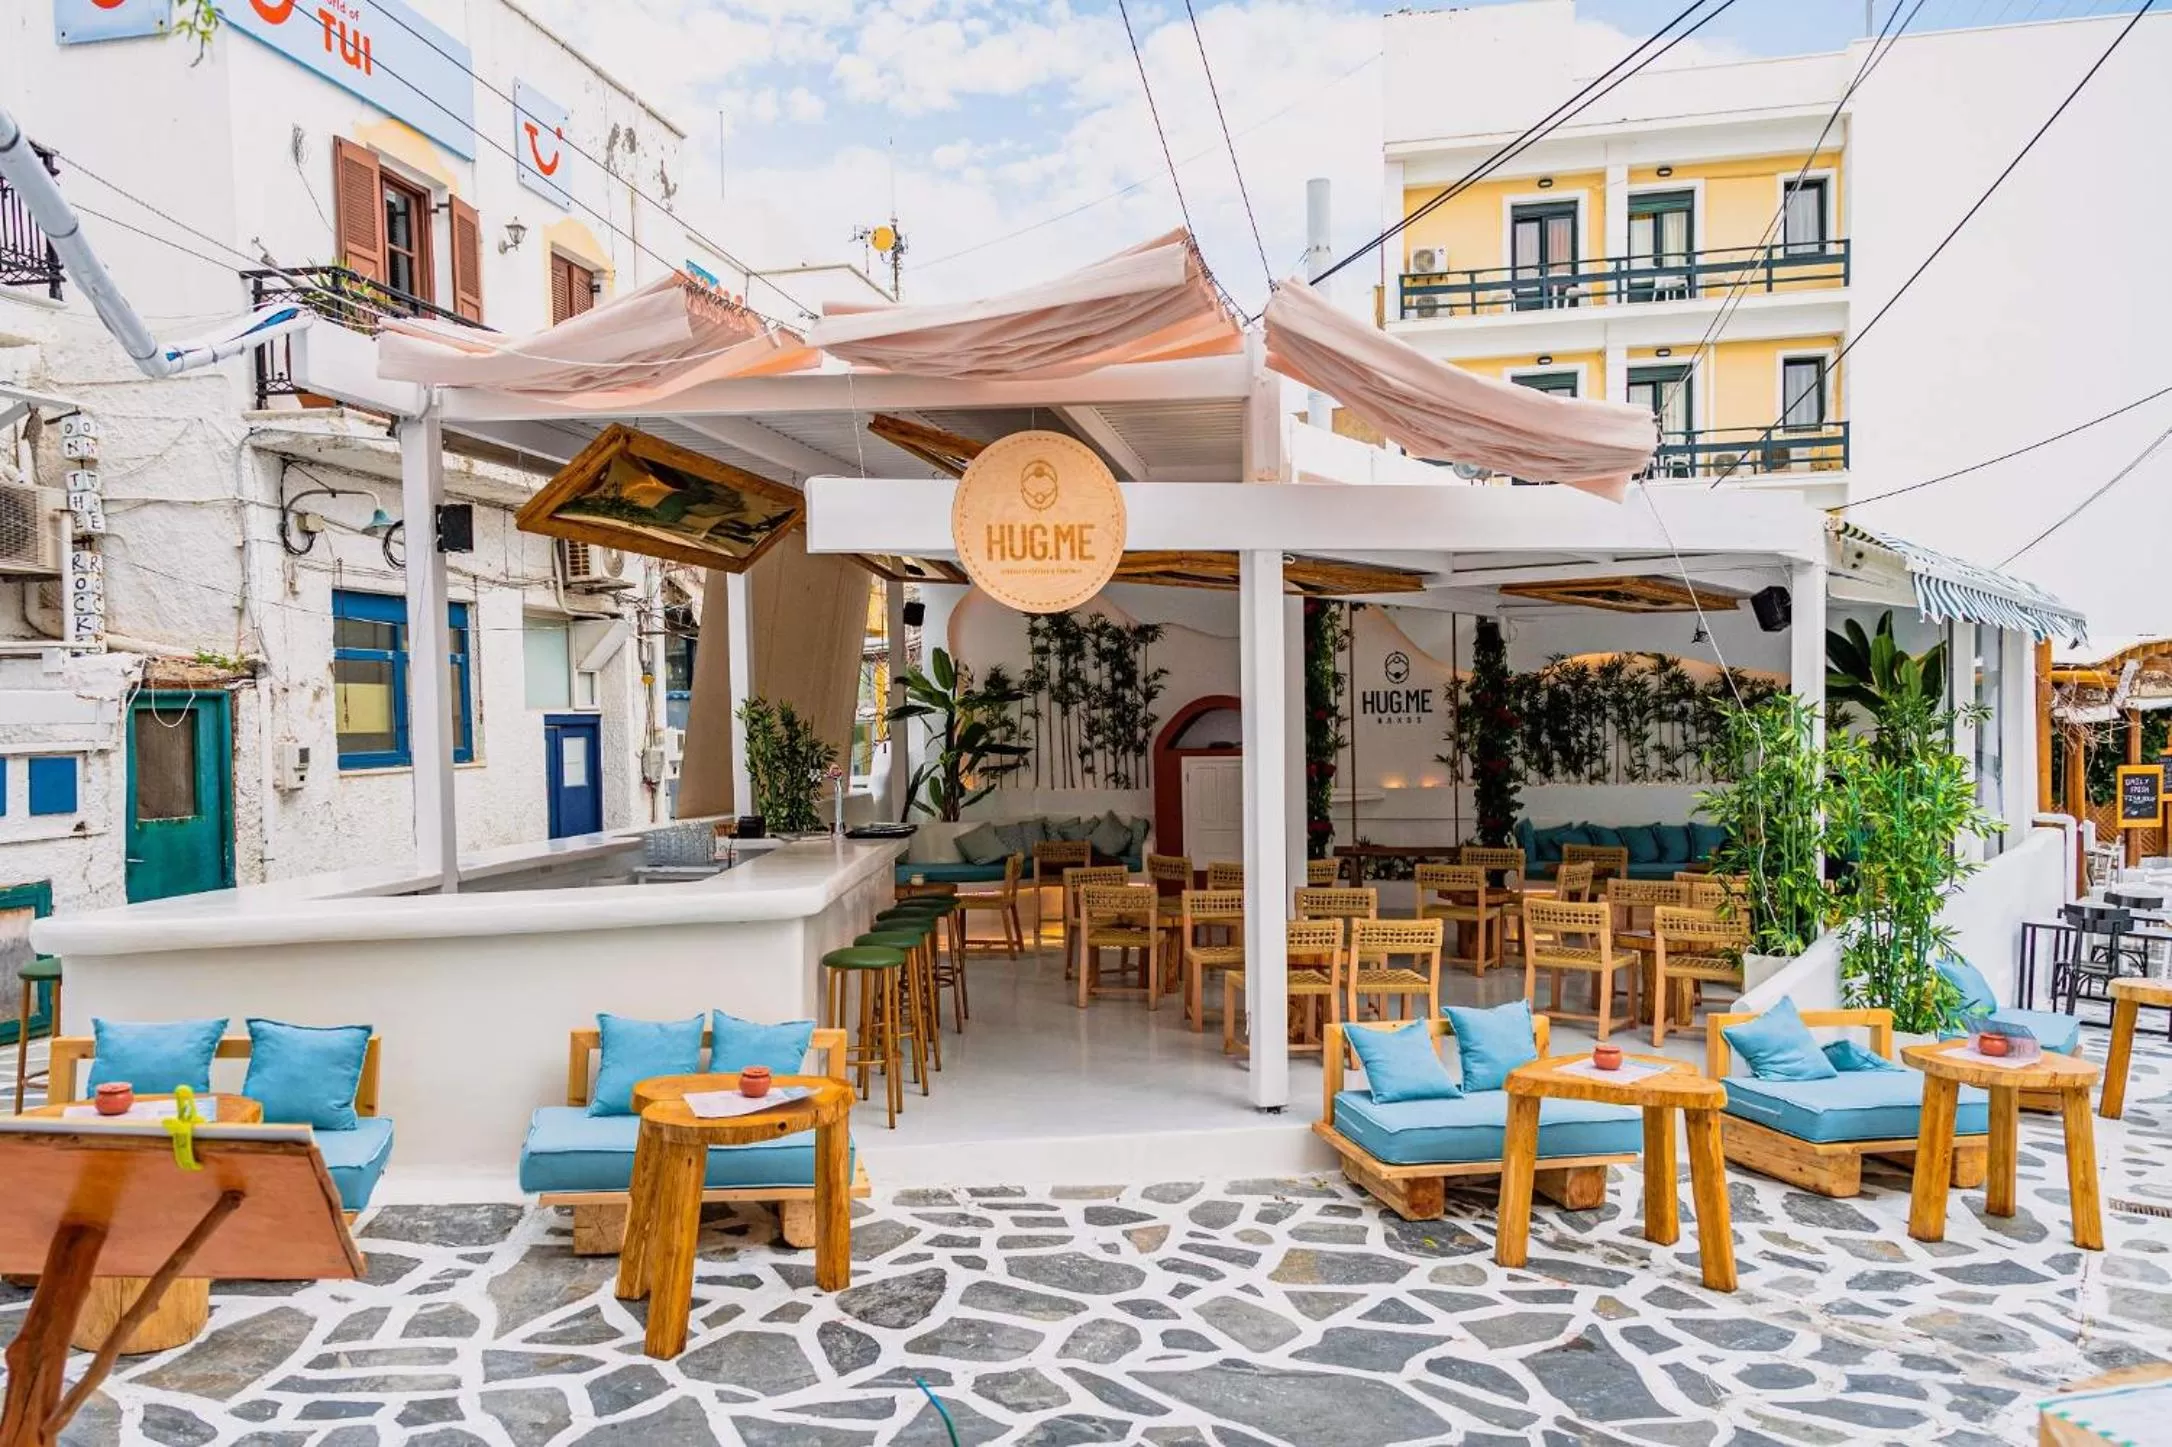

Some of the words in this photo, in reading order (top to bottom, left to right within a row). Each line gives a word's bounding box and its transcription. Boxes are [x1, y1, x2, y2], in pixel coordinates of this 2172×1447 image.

[318, 7, 371, 76] TUI
[986, 523, 1096, 561] HUG.ME
[1362, 689, 1433, 714] HUG.ME
